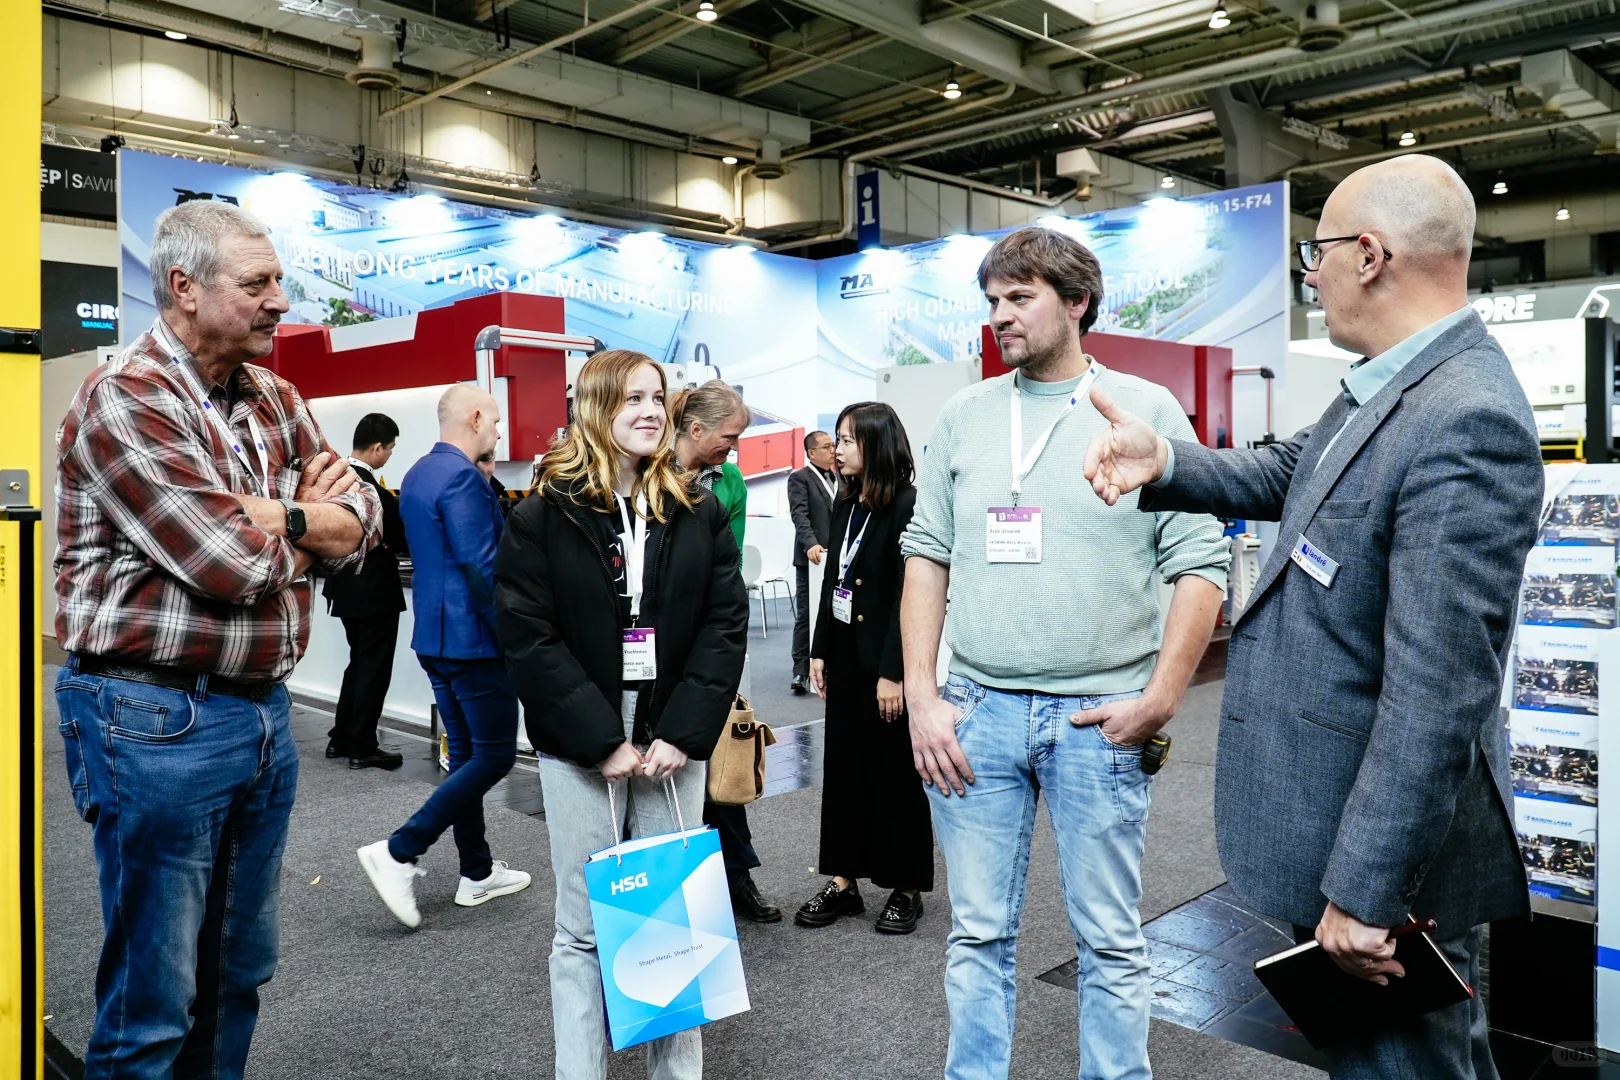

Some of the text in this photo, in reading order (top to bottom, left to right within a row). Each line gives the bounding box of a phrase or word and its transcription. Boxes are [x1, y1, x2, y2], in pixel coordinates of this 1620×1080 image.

[72, 173, 117, 193] SAWI
[1223, 193, 1272, 213] 15-F74
[336, 246, 417, 280] LONG
[425, 257, 510, 291] YEARS
[516, 269, 549, 294] OF
[554, 274, 736, 316] MANUFACTURING
[1123, 266, 1189, 295] TOOL
[924, 290, 990, 319] QUALI
[1308, 548, 1327, 567] landré
[610, 872, 648, 895] HSG
[638, 957, 656, 968] Shape
[673, 948, 690, 957] Shape
[690, 943, 704, 952] Trust
